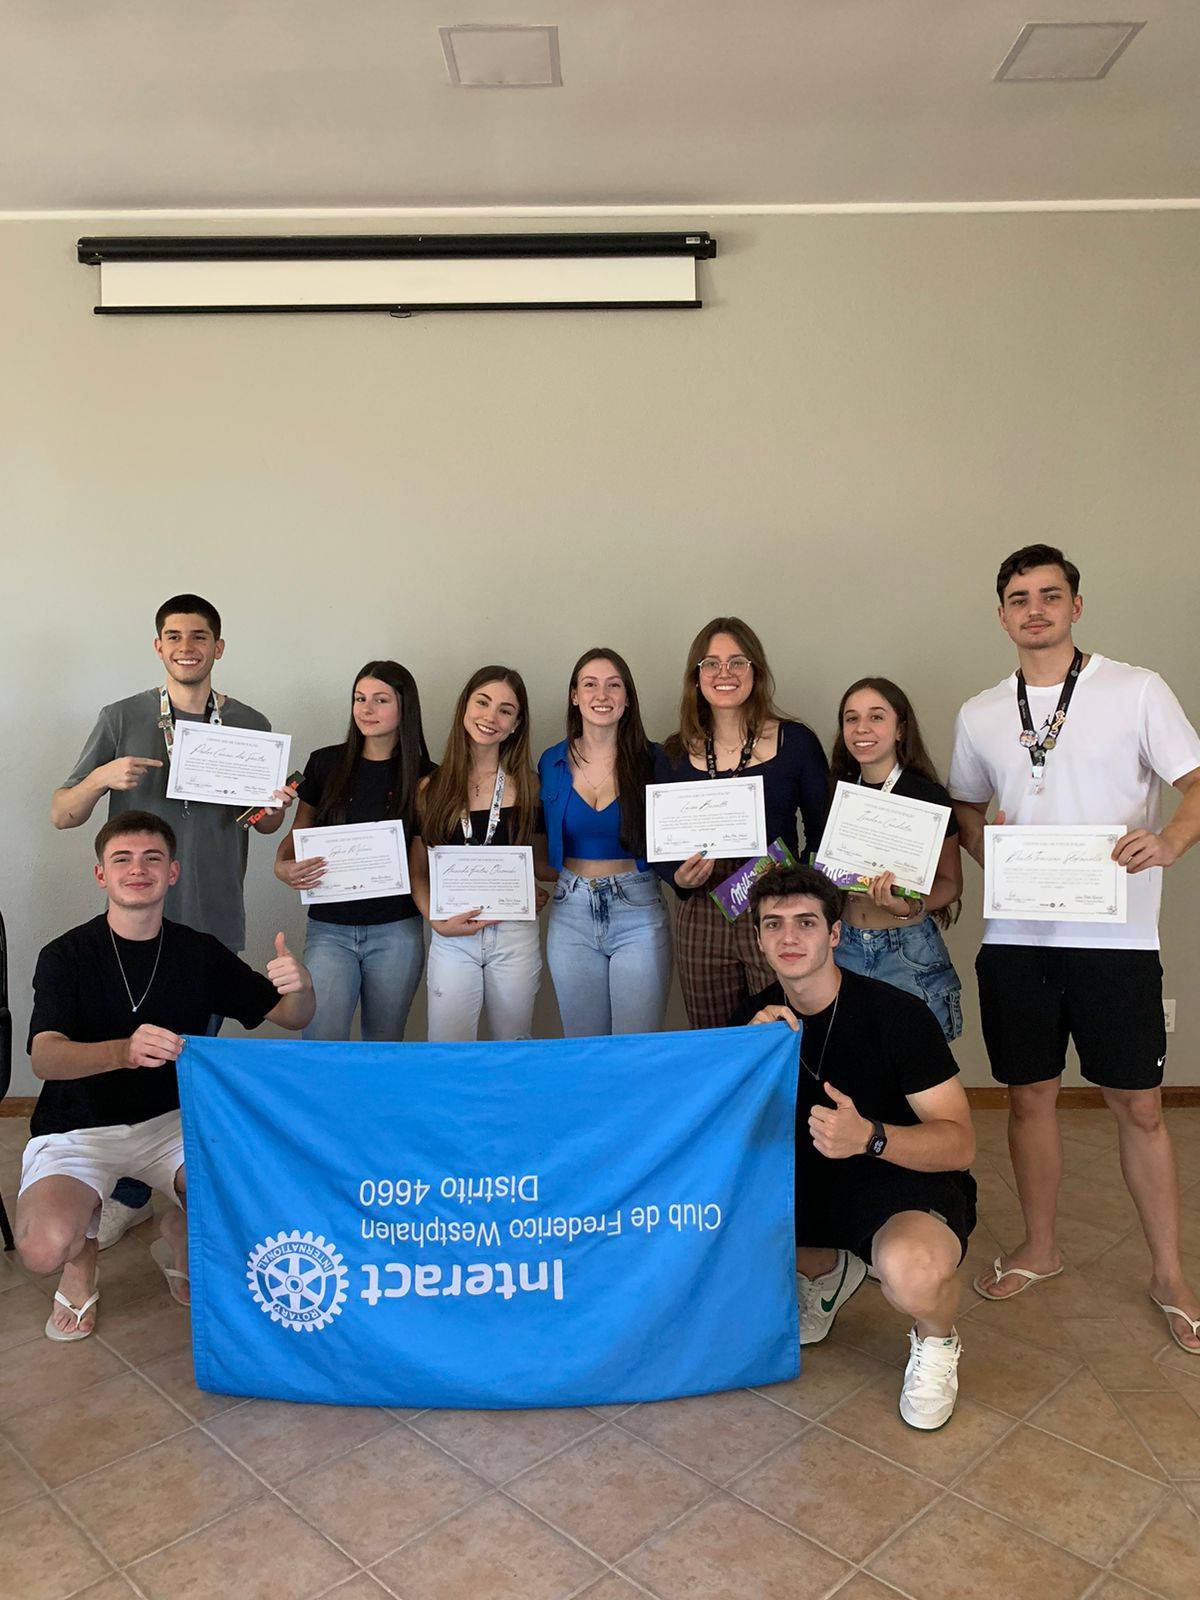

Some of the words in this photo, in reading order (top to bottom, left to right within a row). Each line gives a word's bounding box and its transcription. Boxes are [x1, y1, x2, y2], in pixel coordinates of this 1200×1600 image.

[359, 1179, 431, 1207] 4660
[440, 1175, 539, 1205] Distrito
[361, 1215, 502, 1249] Westphalen
[508, 1209, 622, 1245] Frederico
[630, 1204, 661, 1234] de
[668, 1203, 722, 1233] Club
[257, 1241, 335, 1274] INTERNATIONAL
[360, 1258, 565, 1307] Interact
[273, 1302, 322, 1322] ROTARY
